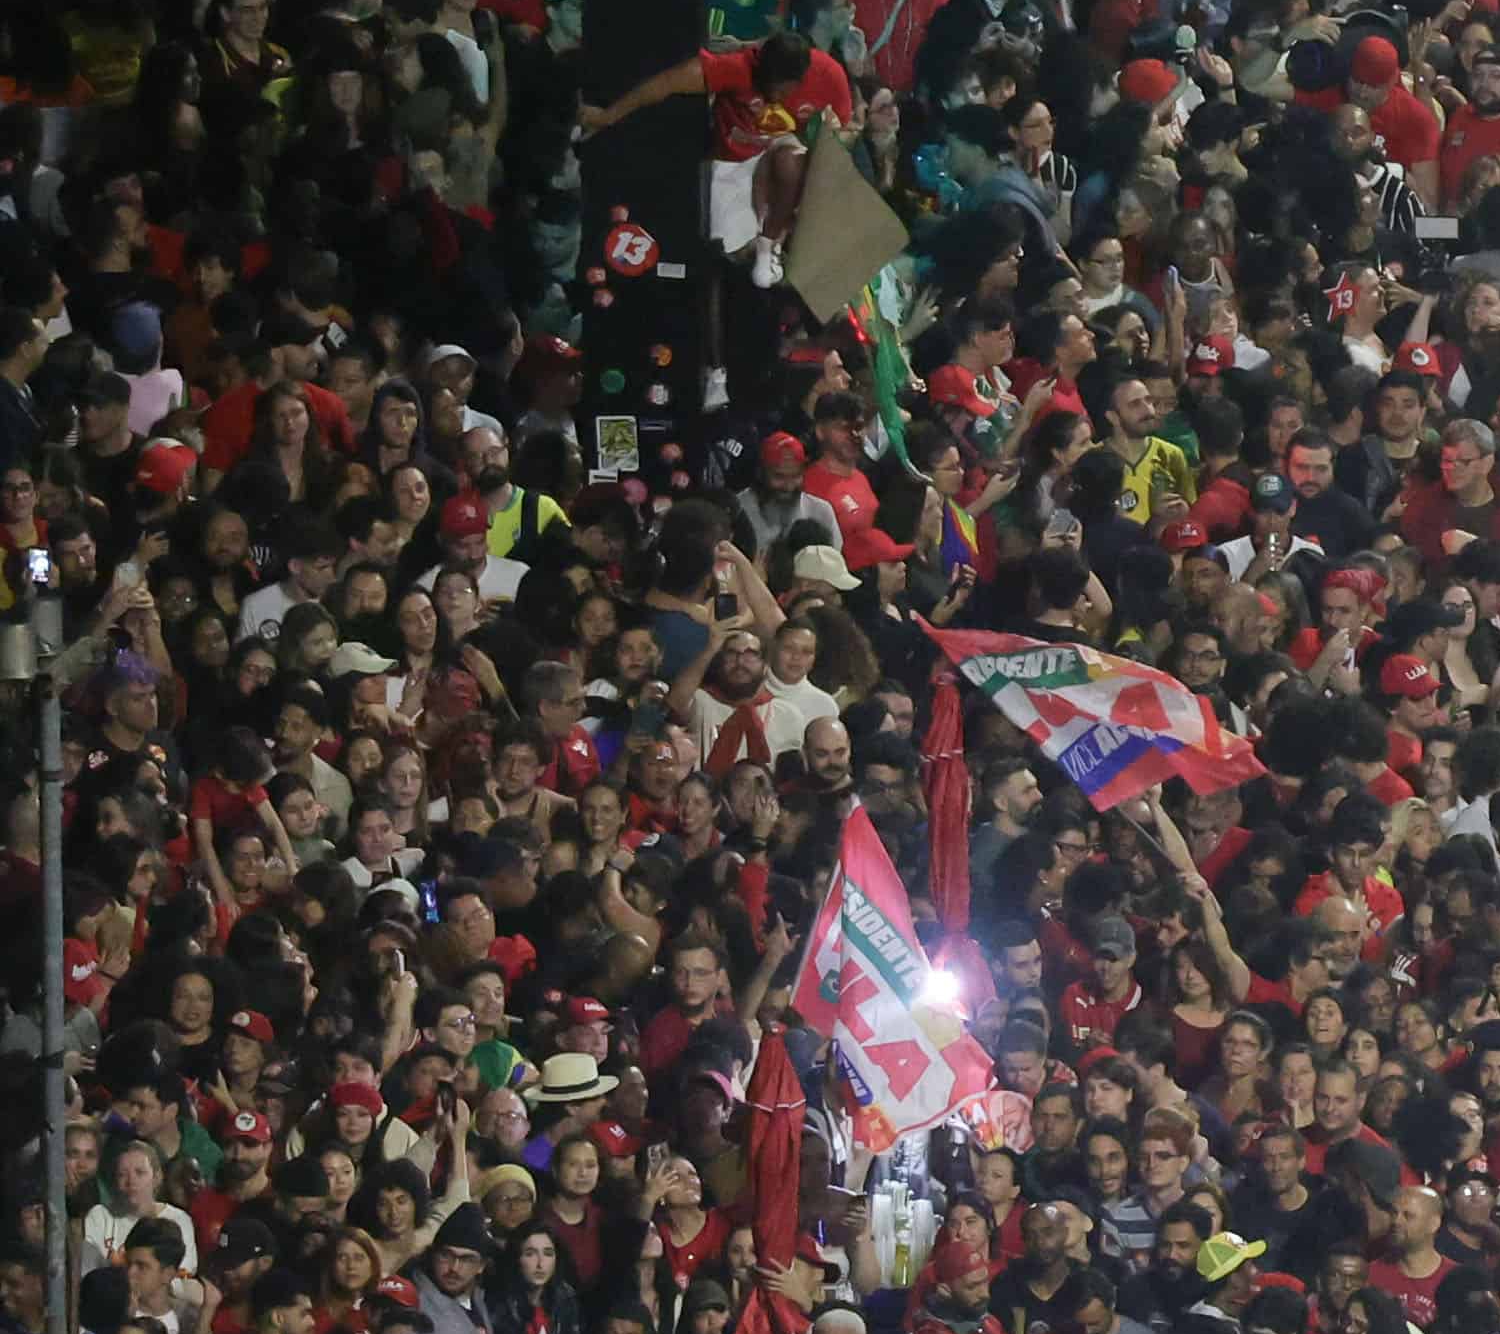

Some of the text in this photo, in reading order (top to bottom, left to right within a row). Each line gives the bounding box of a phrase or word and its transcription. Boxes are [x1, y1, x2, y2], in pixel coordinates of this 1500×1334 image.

[611, 231, 650, 265] 13
[1335, 289, 1354, 309] 13
[1061, 736, 1105, 782] VICE
